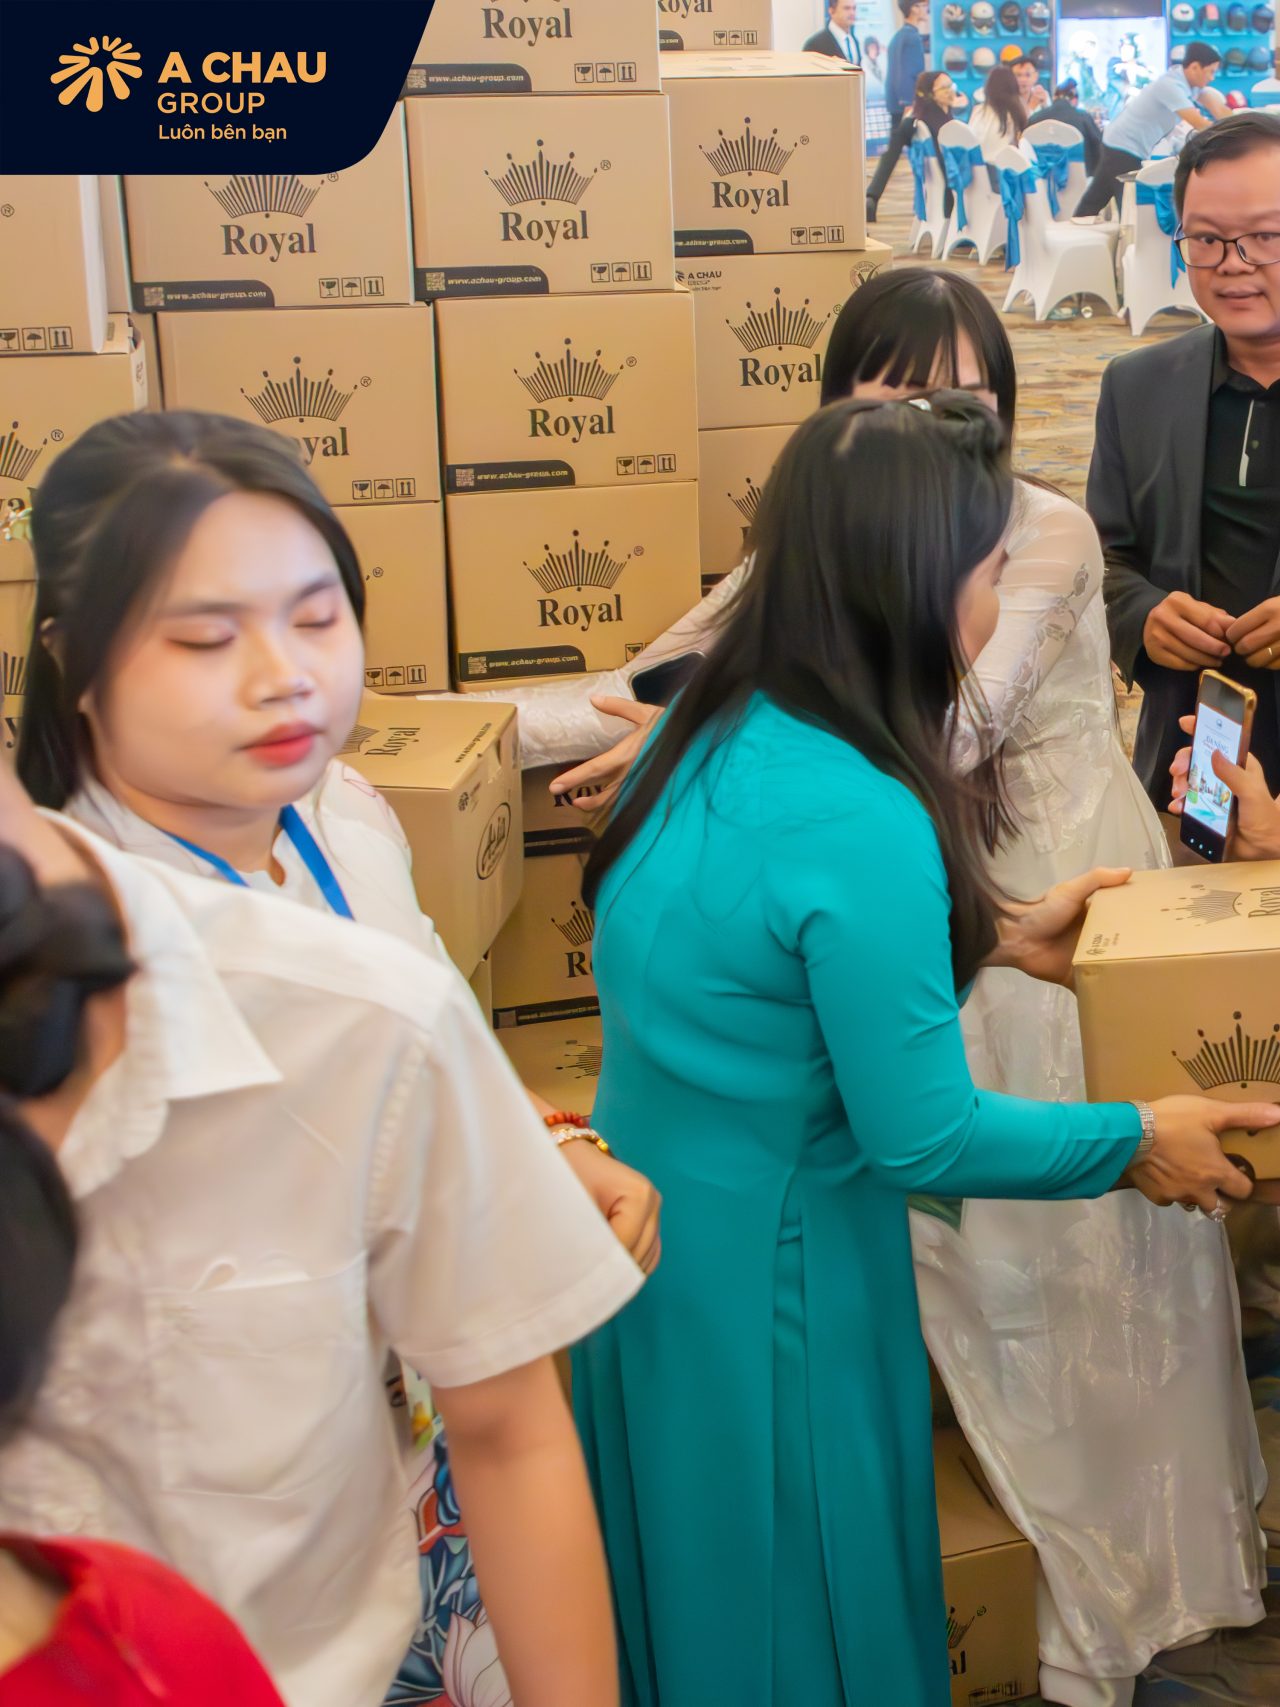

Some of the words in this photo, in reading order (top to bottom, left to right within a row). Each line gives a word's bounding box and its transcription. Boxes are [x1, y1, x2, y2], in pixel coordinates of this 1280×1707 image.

[482, 8, 573, 47] Royal
[710, 180, 790, 215] Royal
[220, 222, 317, 263] Royal
[499, 210, 590, 249] Royal
[696, 270, 722, 280] CHAU
[739, 354, 822, 392] Royal
[528, 406, 616, 444] Royal
[302, 426, 350, 466] yal
[537, 594, 624, 632] Royal
[363, 727, 421, 757] Royal
